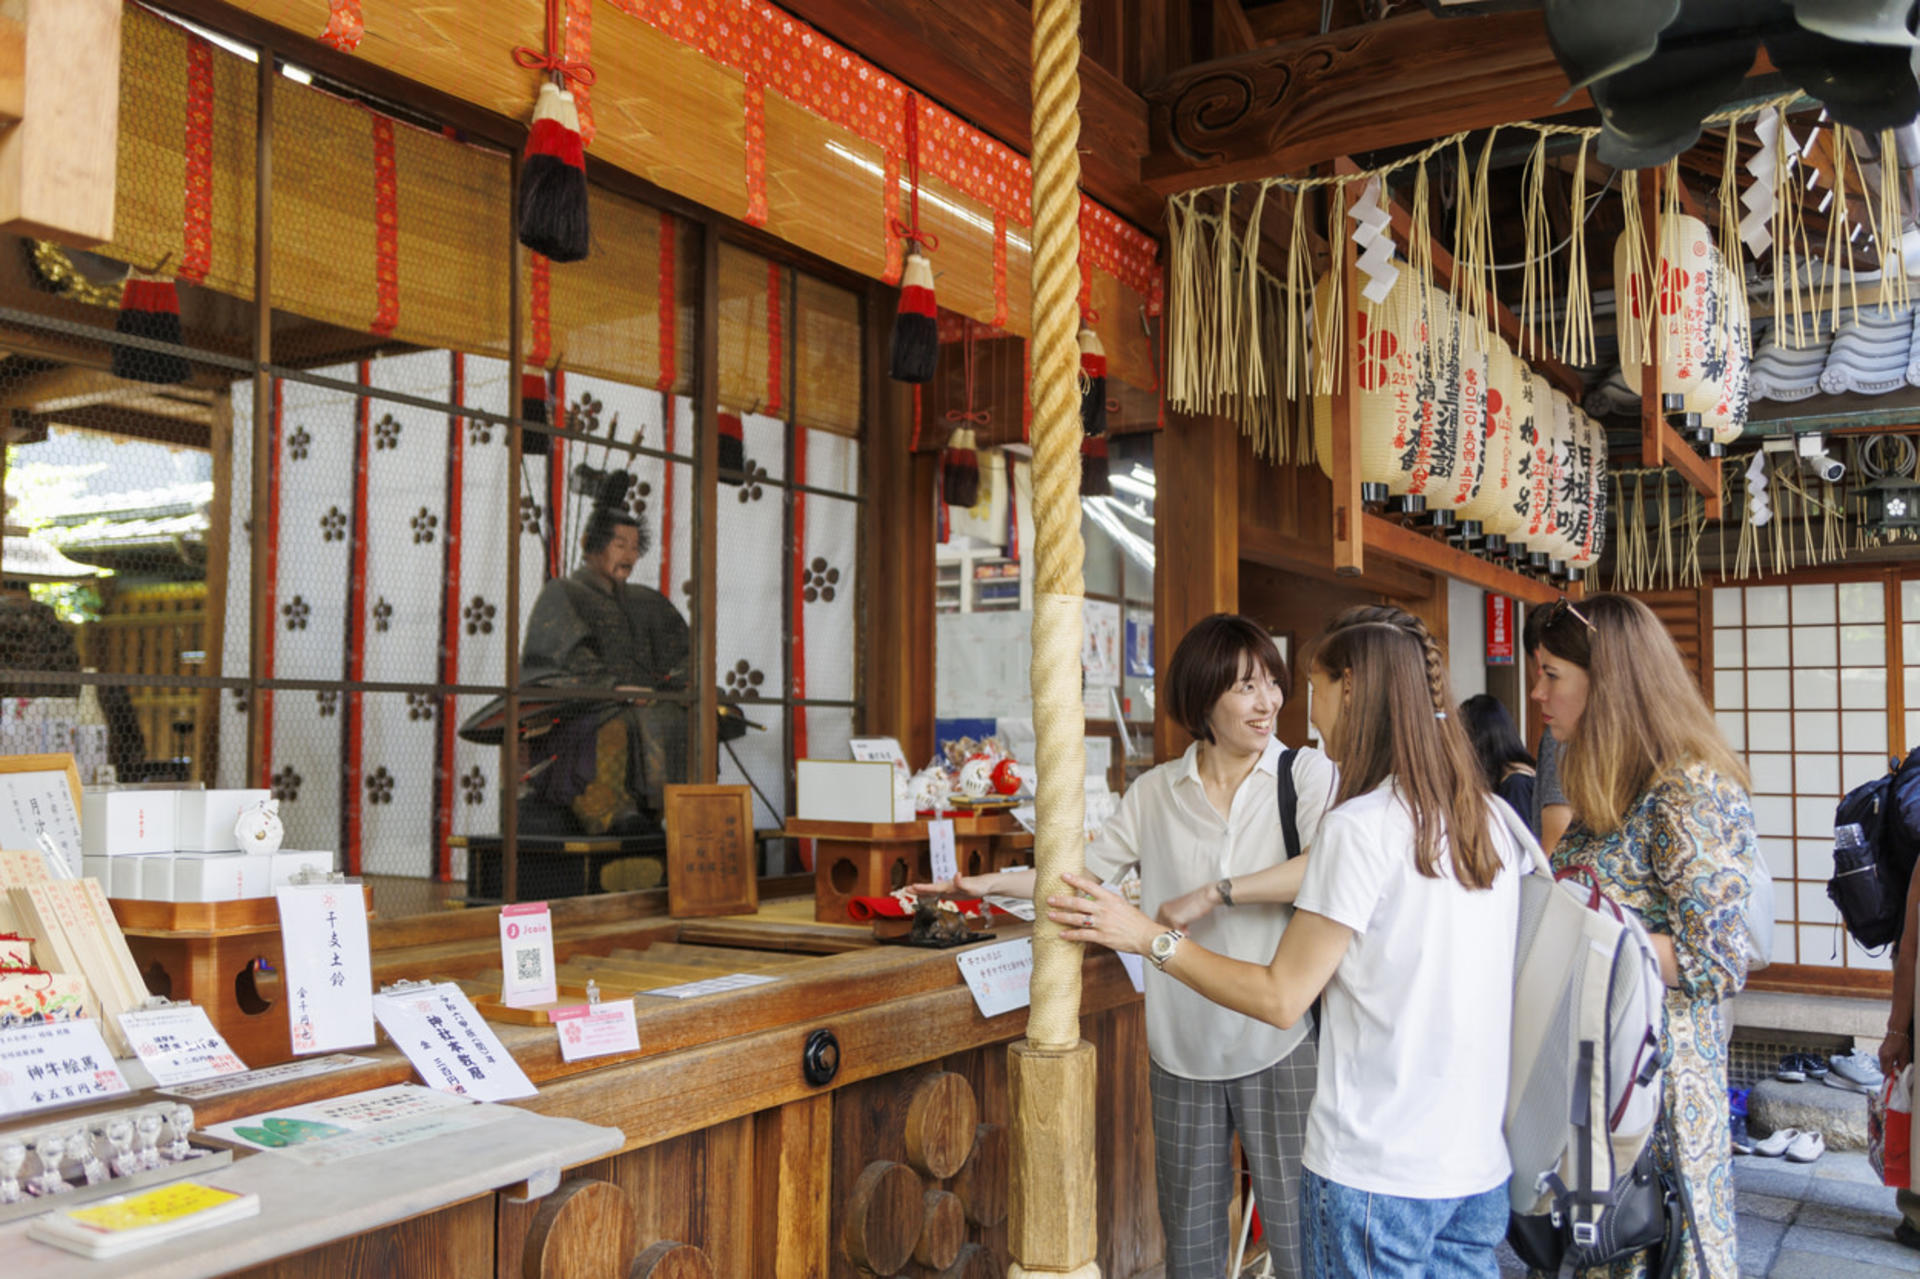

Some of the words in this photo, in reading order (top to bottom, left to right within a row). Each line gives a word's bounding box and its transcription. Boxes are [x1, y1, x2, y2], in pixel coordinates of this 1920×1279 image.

[326, 911, 345, 987] 干支土鈴
[26, 1055, 100, 1081] 神牛絵馬
